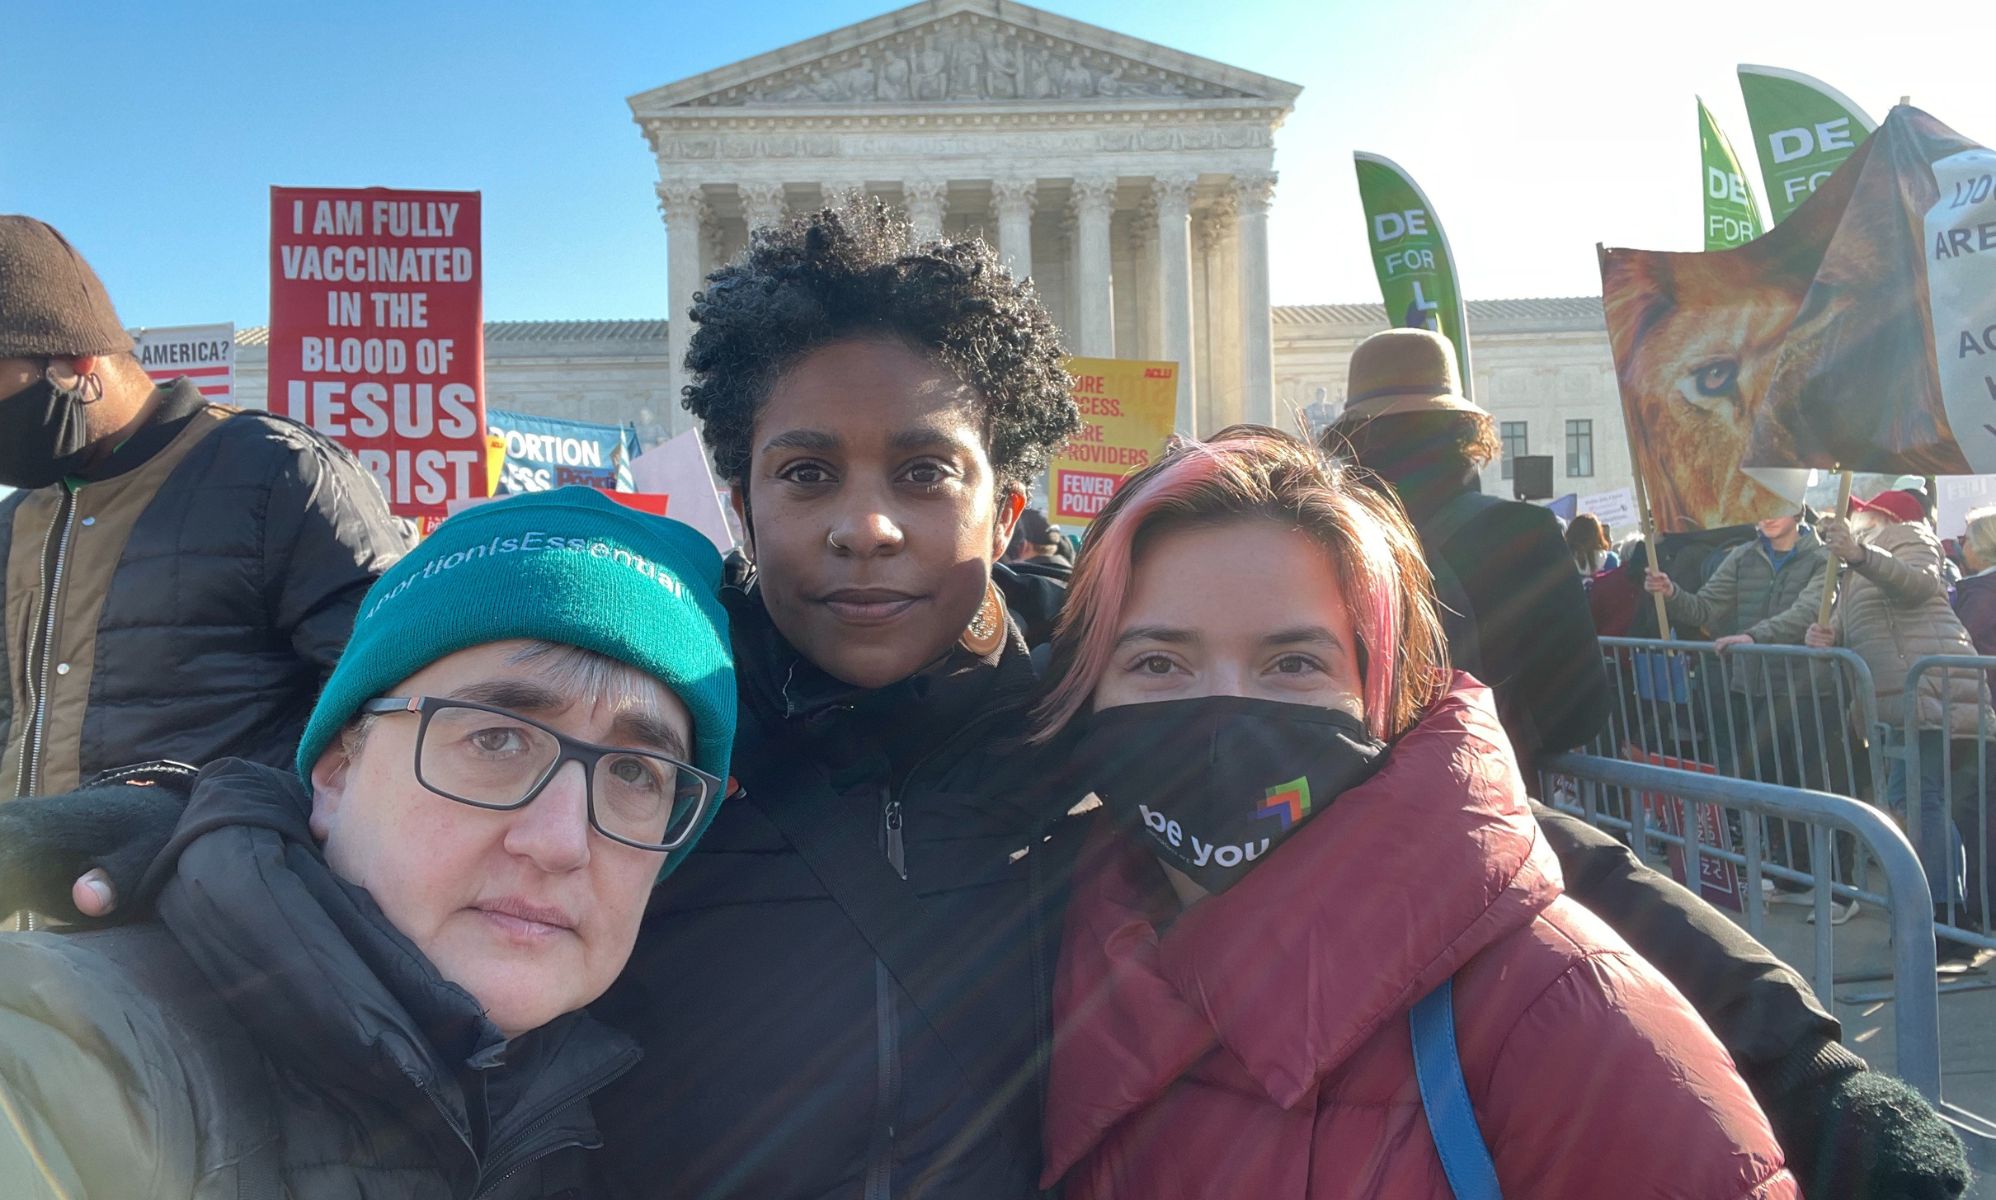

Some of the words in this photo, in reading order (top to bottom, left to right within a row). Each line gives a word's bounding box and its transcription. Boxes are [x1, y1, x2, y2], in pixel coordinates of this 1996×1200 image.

[1769, 117, 1855, 164] DE
[1708, 166, 1748, 206] DE
[293, 200, 303, 234] I
[313, 200, 363, 236] AM
[372, 202, 459, 237] FULLY
[1374, 209, 1428, 242] DE
[1710, 215, 1754, 241] FOR
[281, 246, 472, 282] VACCINATED
[1384, 249, 1435, 275] FOR
[328, 291, 360, 327] IN
[371, 293, 427, 328] THE
[141, 341, 229, 364] AMERICA?
[302, 337, 406, 374] BLOOD
[416, 339, 453, 374] OF
[489, 427, 601, 468] ORTION
[357, 449, 478, 505] RIST
[1063, 474, 1114, 496] FEWER
[1139, 805, 1183, 847] be
[1191, 836, 1270, 867] you
